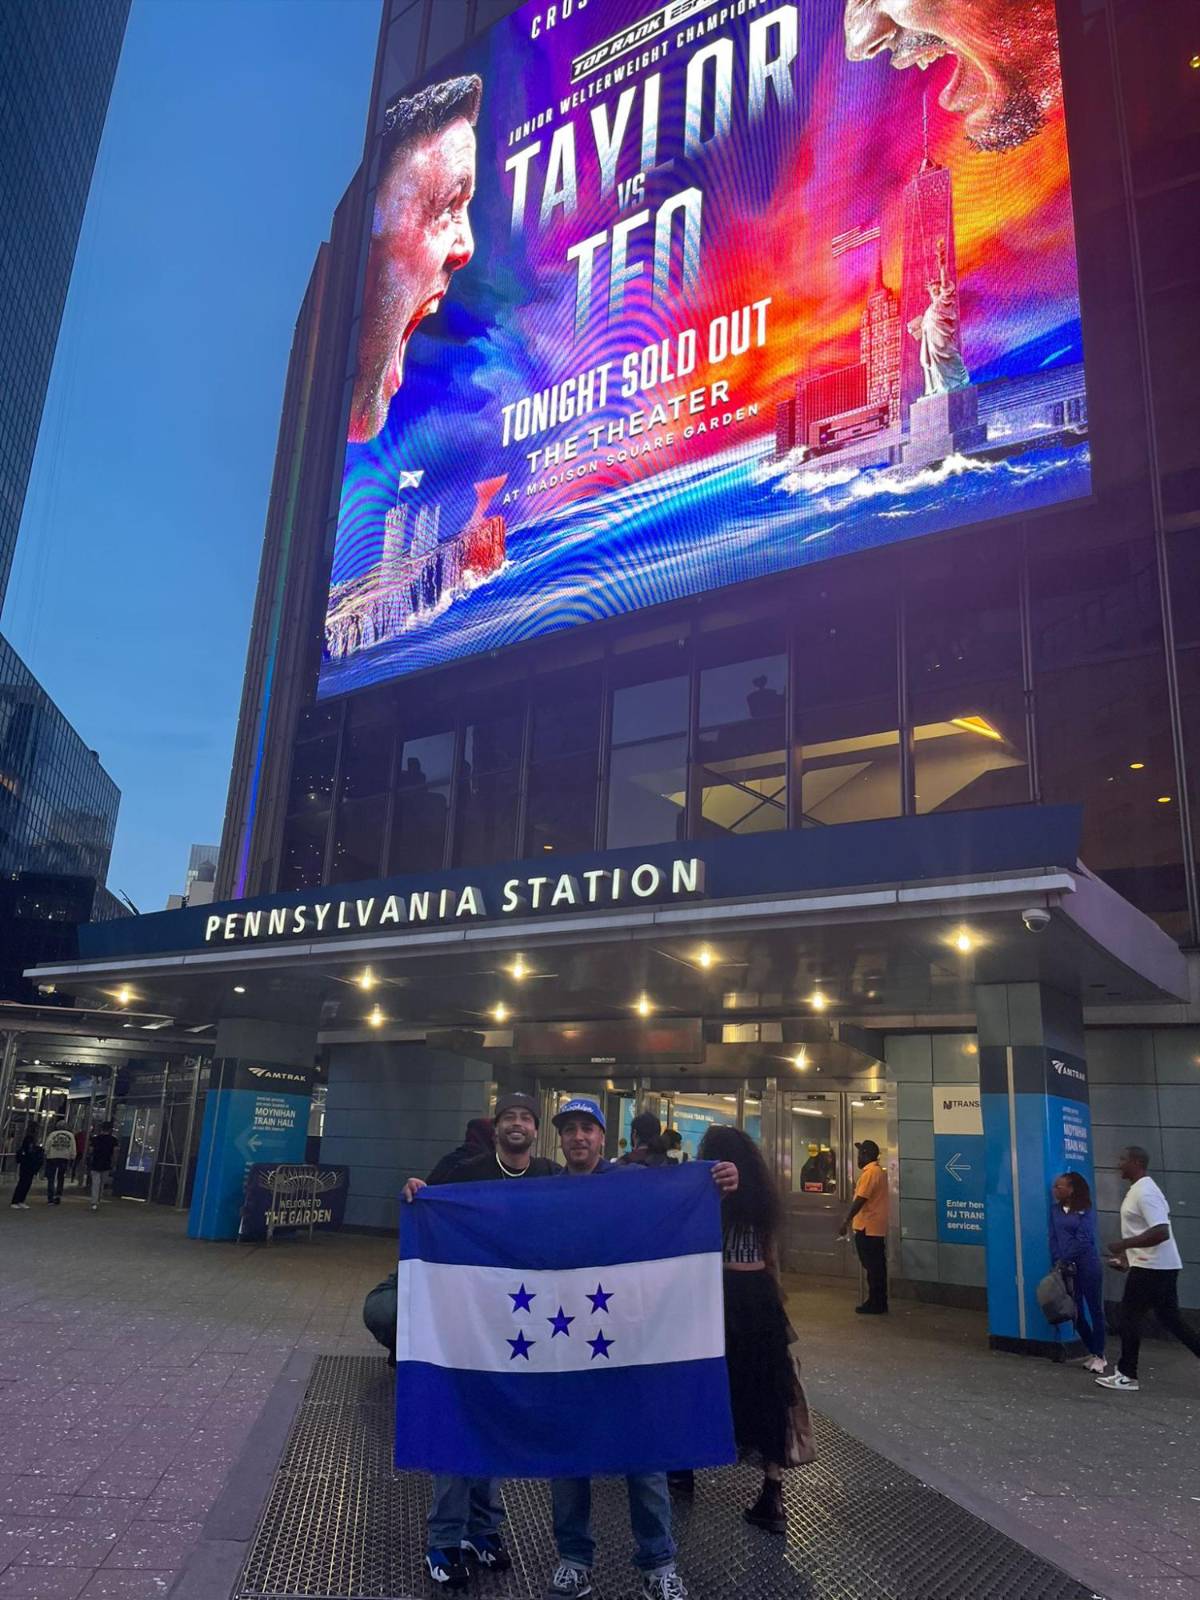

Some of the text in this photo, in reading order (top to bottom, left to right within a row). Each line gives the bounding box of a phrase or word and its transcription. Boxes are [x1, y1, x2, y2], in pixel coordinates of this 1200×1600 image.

[508, 0, 767, 147] JUNIOR WELTERWEIGHT CHAMPION
[573, 48, 608, 77] TOP
[610, 15, 663, 60] RANK
[505, 4, 798, 240] TAYLOR
[617, 172, 646, 213] VS
[566, 186, 703, 338] TEO
[501, 297, 772, 448] TONIGHT SOLD OUT
[502, 403, 759, 505] AT MADISON SQUARE GARDEN
[527, 380, 731, 475] THE THEATER
[205, 858, 699, 941] PENNSYLVANIA STATION
[264, 1071, 306, 1082] AMTRAK
[254, 1116, 294, 1128] TRAIN HALL
[255, 1107, 296, 1118] MOYNIHAN
[264, 1208, 332, 1226] THE GARDEN
[946, 1200, 967, 1208] Enter
[947, 1221, 982, 1231] services.
